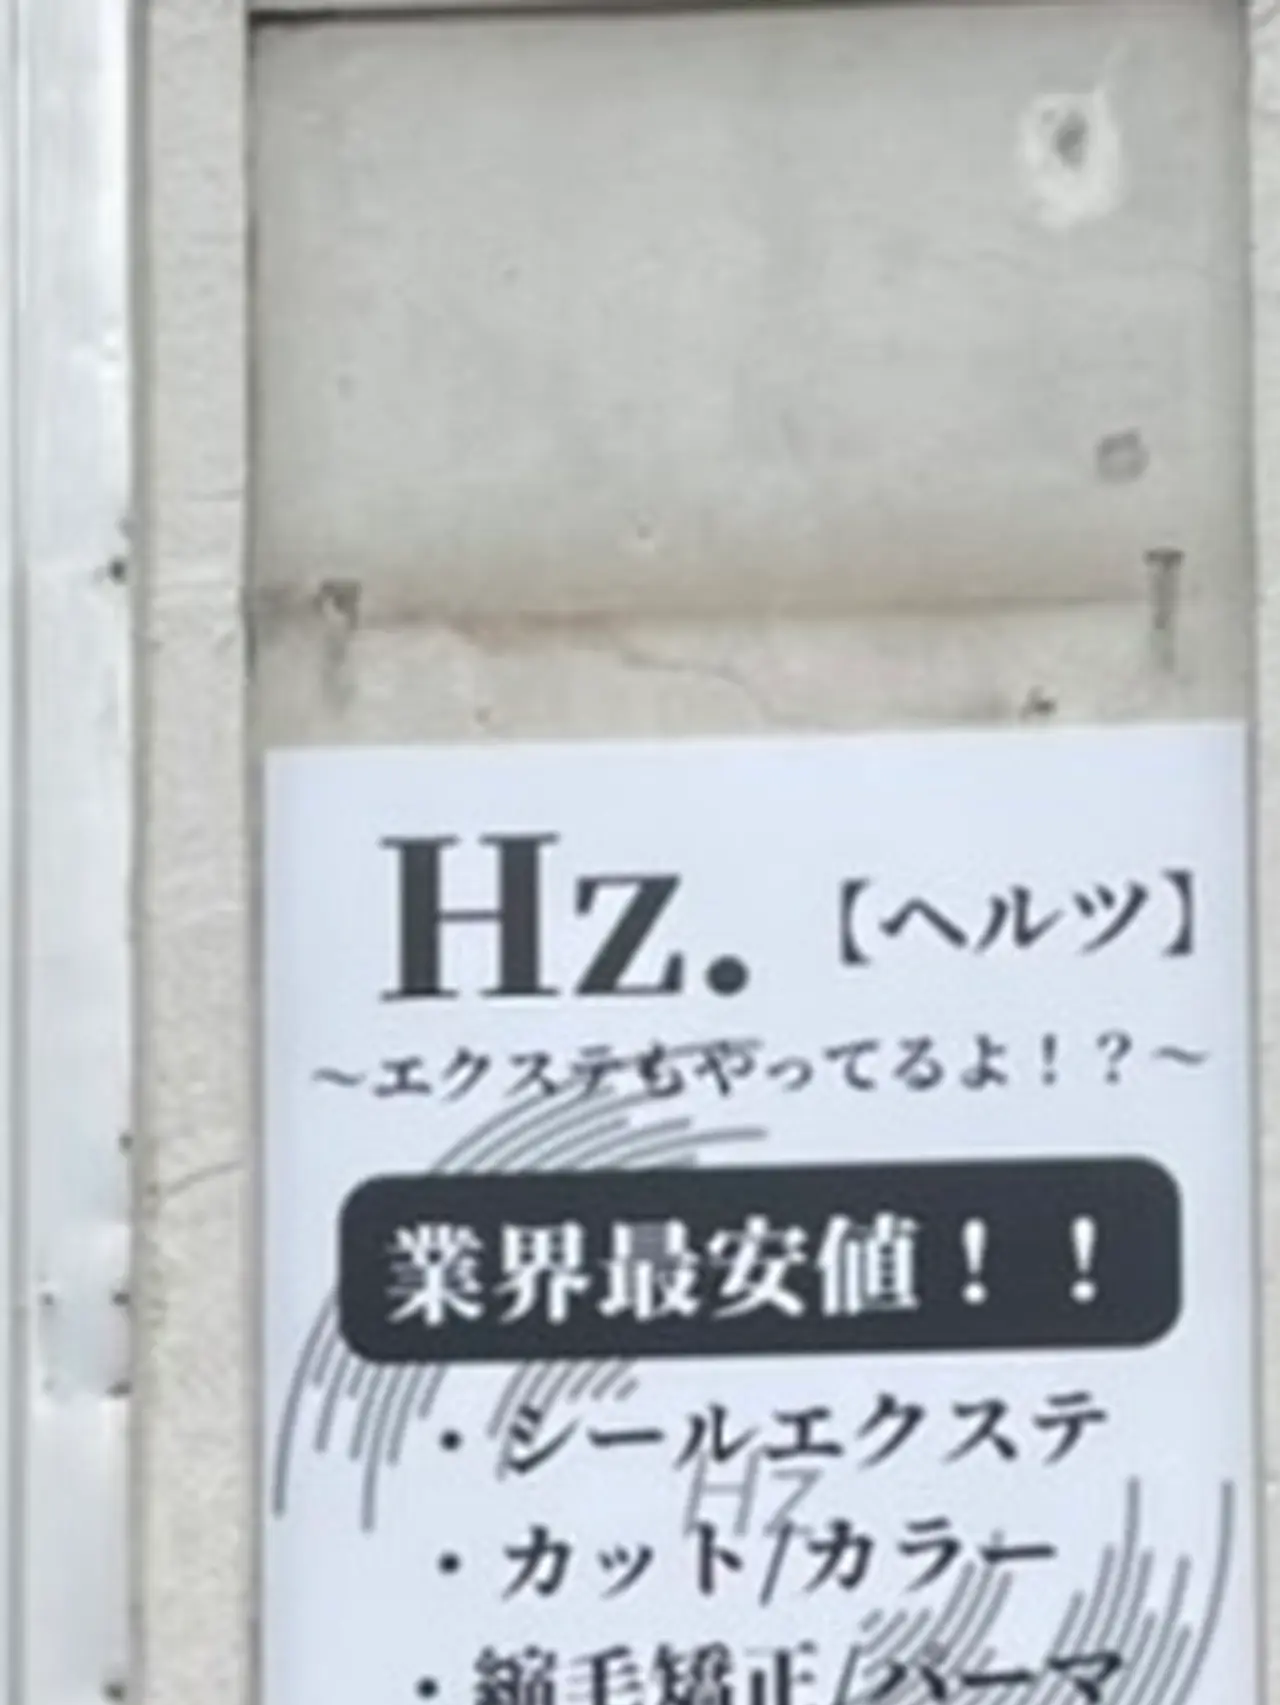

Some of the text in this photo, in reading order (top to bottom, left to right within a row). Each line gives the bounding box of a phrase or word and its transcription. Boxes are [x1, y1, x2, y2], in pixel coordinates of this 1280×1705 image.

[380, 831, 749, 1001] Hz.
[386, 1212, 1098, 1325] 業界最安値！！
